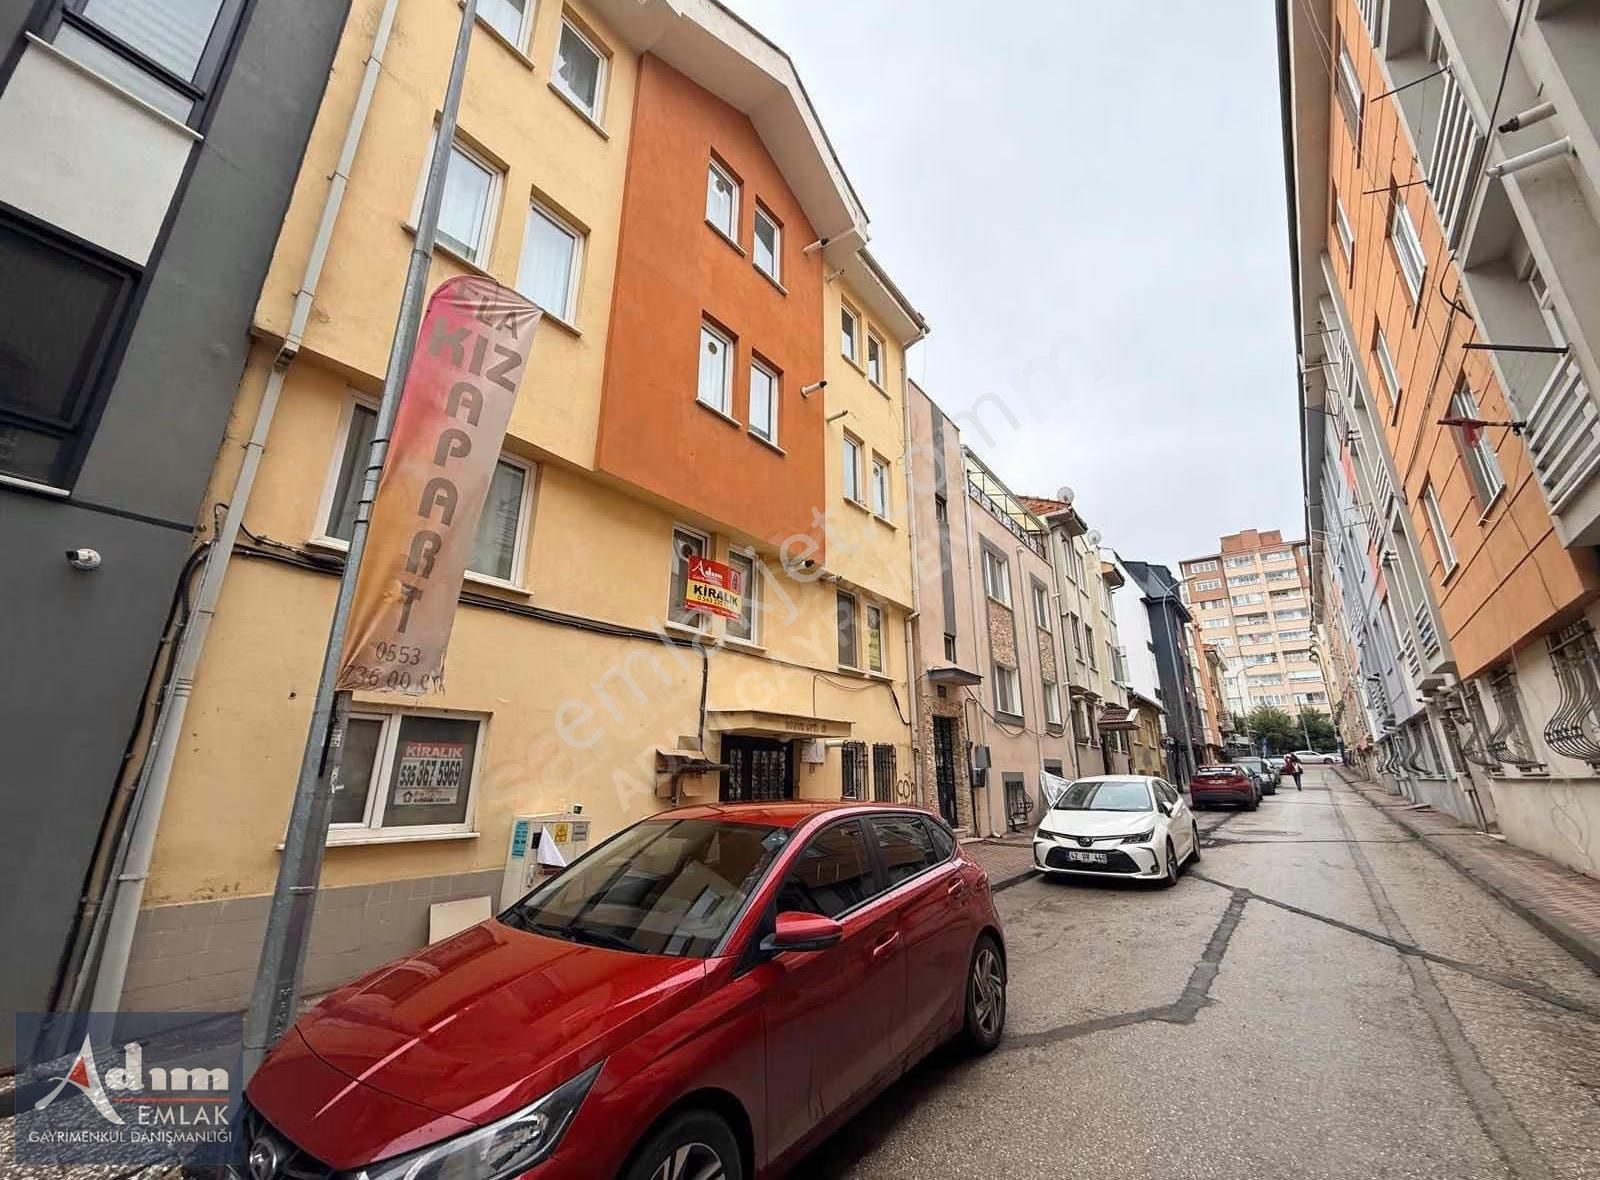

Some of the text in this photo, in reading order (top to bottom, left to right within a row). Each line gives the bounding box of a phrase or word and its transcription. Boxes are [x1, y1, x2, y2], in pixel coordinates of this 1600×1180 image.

[428, 316, 523, 394] KIZ
[398, 381, 484, 635] APART
[694, 584, 738, 606] KİRALIK
[376, 641, 421, 666] 0553
[405, 743, 463, 758] KİRALIK
